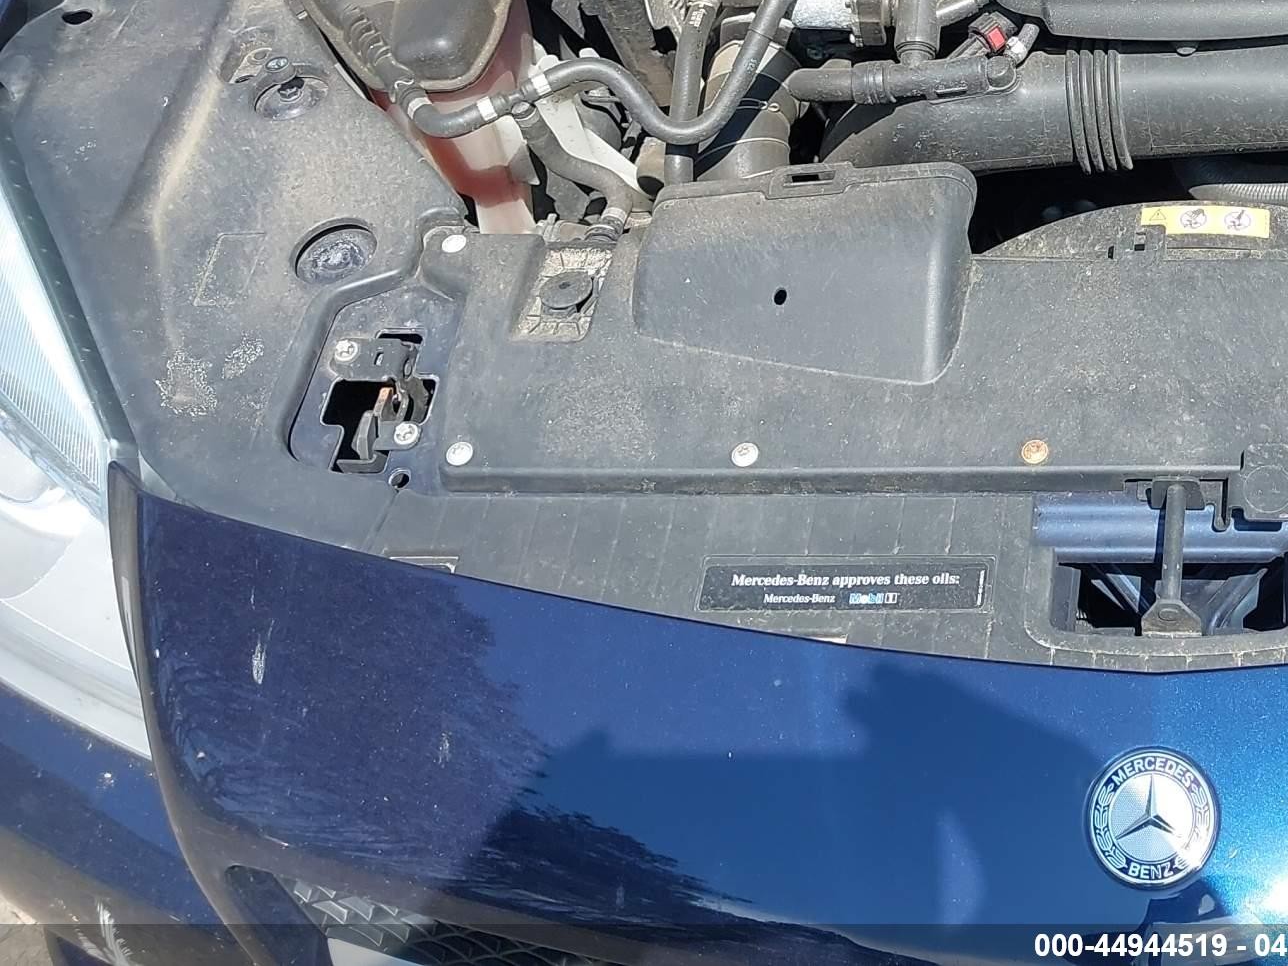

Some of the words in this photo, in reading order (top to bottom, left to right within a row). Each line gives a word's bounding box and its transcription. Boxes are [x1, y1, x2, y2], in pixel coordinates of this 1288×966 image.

[731, 573, 830, 586] Mercedes-Benz
[832, 574, 891, 589] approves
[894, 572, 930, 585] these
[932, 572, 961, 585] oils:
[763, 593, 836, 604] Mercedes-Benz
[848, 592, 885, 604] Mobil
[1111, 756, 1195, 788] MERCEDES
[1128, 863, 1174, 881] BENZ
